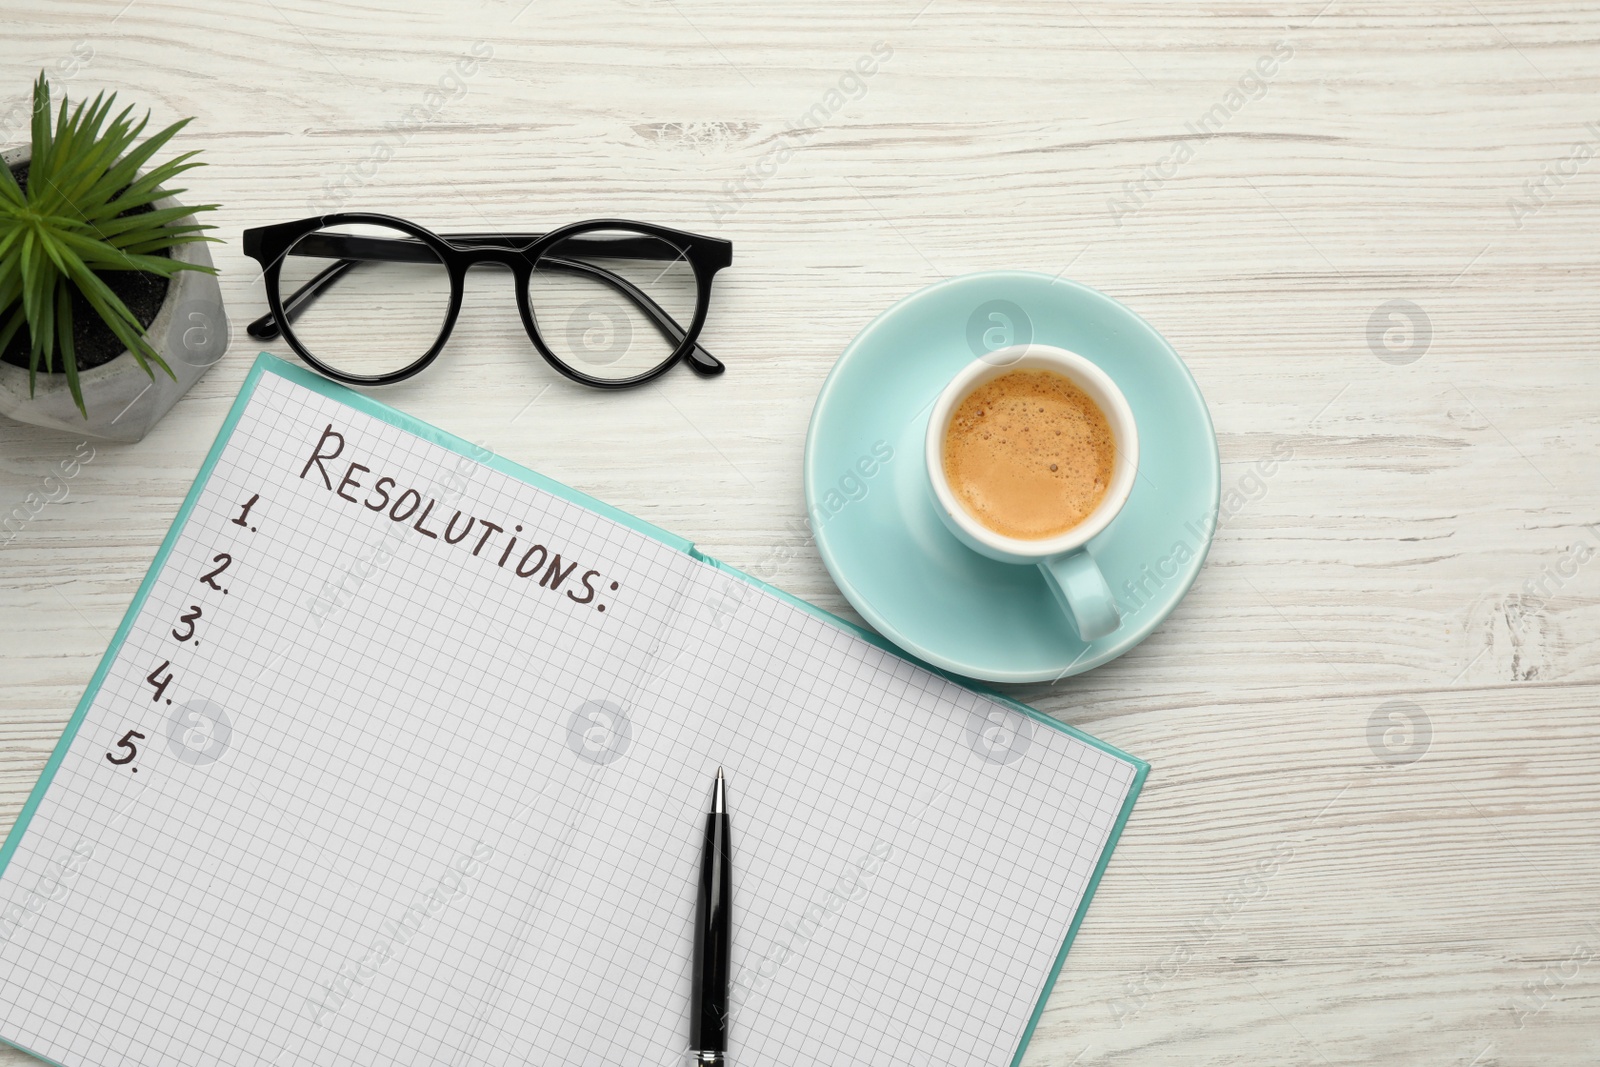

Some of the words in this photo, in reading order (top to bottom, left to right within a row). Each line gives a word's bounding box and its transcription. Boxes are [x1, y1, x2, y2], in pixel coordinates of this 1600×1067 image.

[231, 493, 259, 533] 1.
[199, 553, 231, 596] 2.
[172, 605, 203, 647] 3.
[146, 660, 174, 707] 4.
[106, 729, 146, 774] 5.
